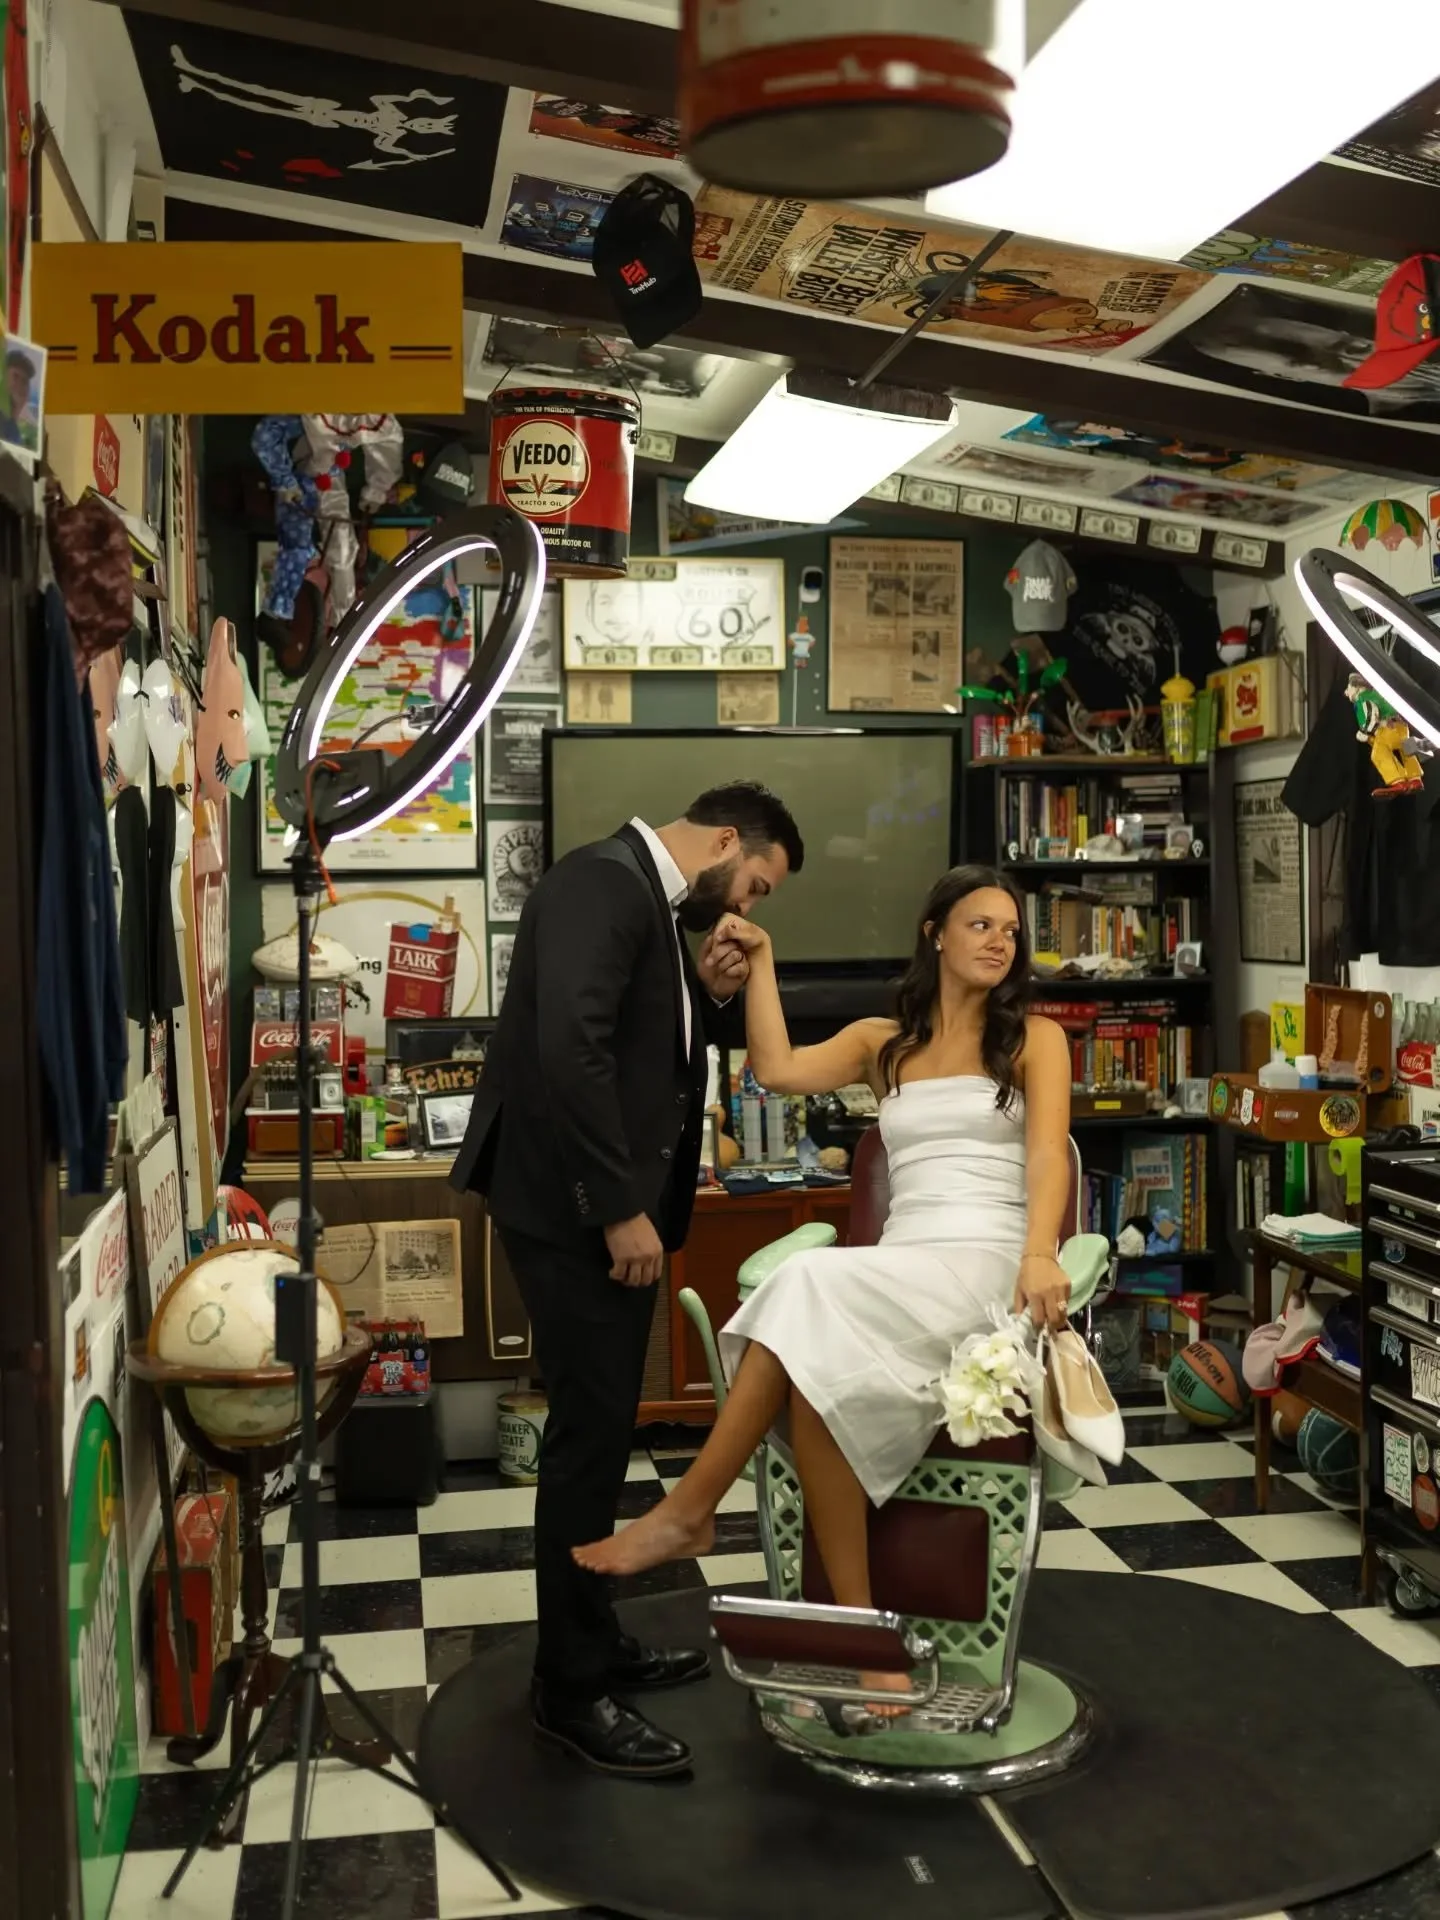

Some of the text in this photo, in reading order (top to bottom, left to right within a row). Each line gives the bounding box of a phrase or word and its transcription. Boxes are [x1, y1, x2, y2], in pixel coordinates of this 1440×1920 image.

[766, 200, 808, 242] SATURDAY
[787, 224, 880, 305] VALLEY BOYS
[818, 227, 927, 315] WHISKEY BENT
[628, 277, 657, 295] TireHub
[91, 294, 375, 364] Kodak
[513, 440, 580, 475] VEEDOL
[540, 527, 566, 536] QUALITY
[561, 539, 582, 548] MOTOR
[583, 540, 592, 548] OIL
[689, 607, 743, 638] 60
[393, 947, 441, 972] LARK
[406, 1065, 475, 1092] Fehr's
[142, 1170, 180, 1268] BARBER
[1187, 1343, 1224, 1384] Wilson
[1176, 1370, 1200, 1400] NBA
[518, 1455, 531, 1464] OIL
